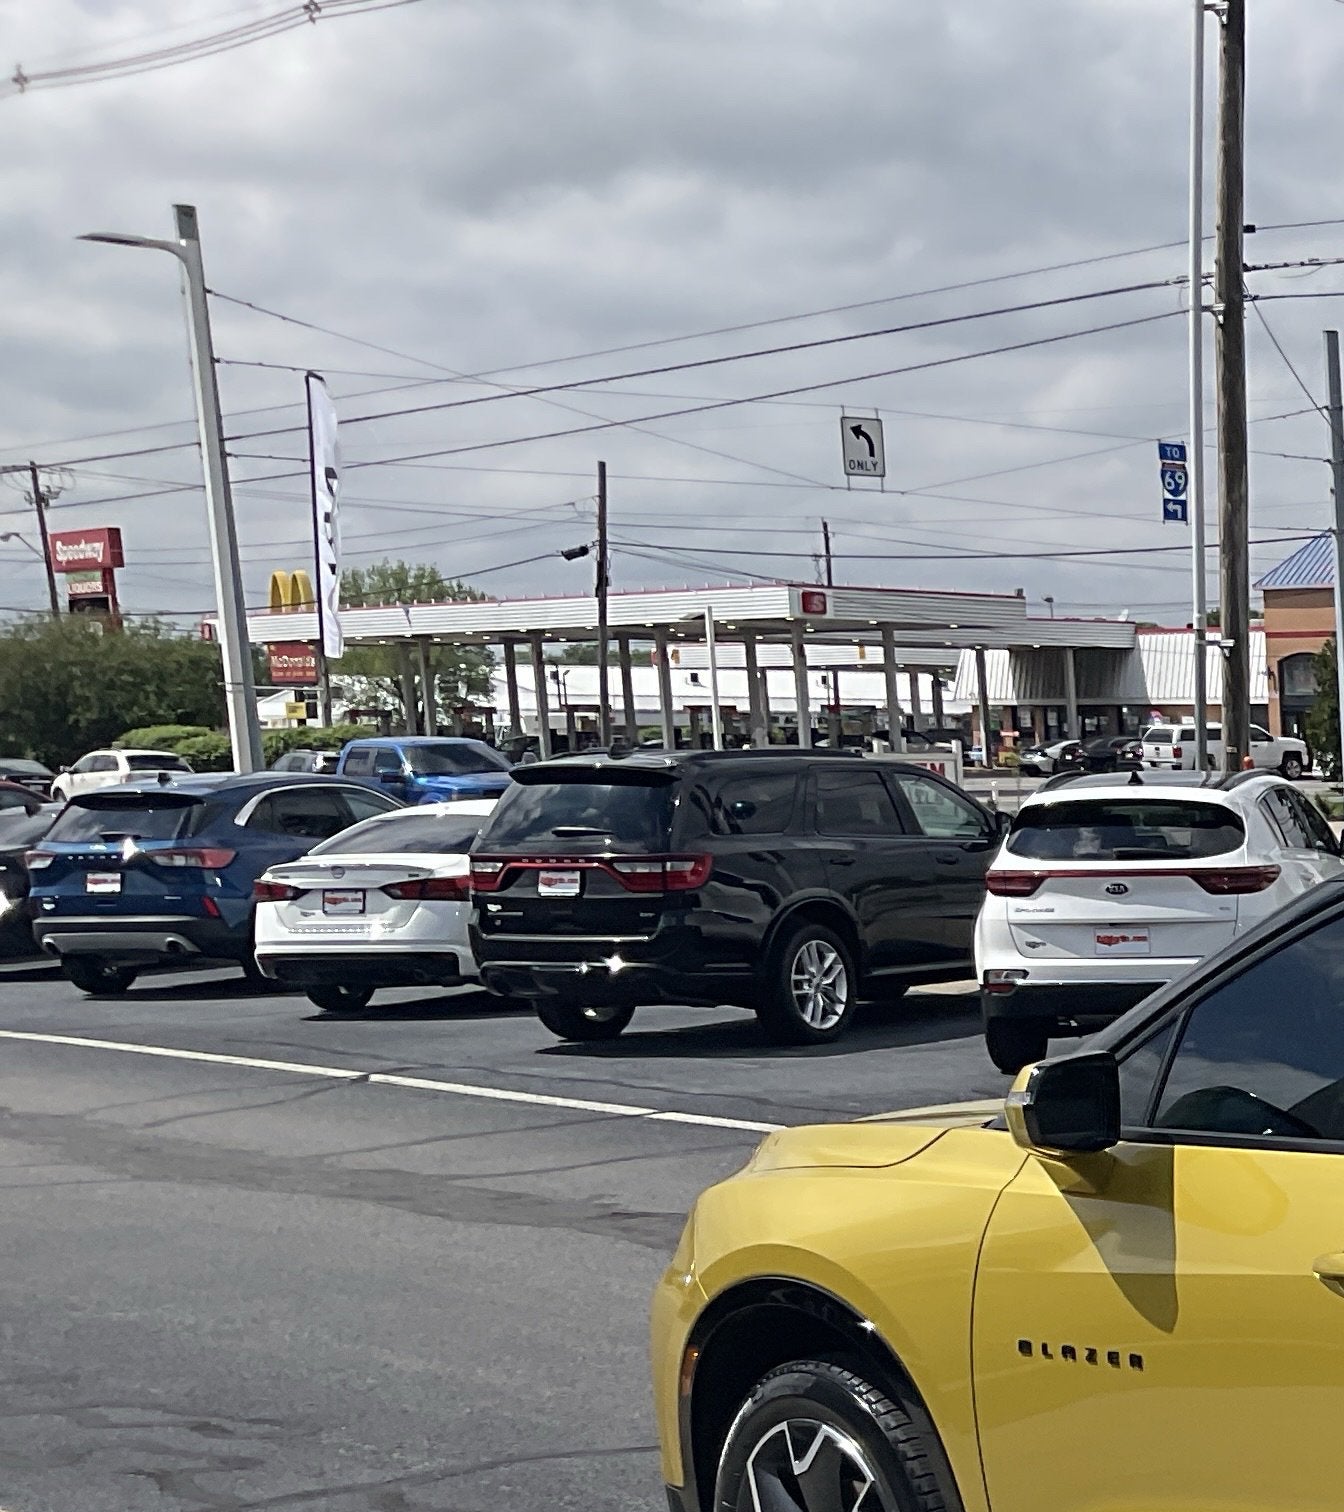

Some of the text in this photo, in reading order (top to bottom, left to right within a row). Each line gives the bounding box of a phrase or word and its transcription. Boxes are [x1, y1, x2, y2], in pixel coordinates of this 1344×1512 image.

[1165, 446, 1180, 459] TO
[848, 459, 879, 472] ONLY
[1164, 471, 1186, 490] 69
[1018, 1339, 1144, 1372] BLAZER
